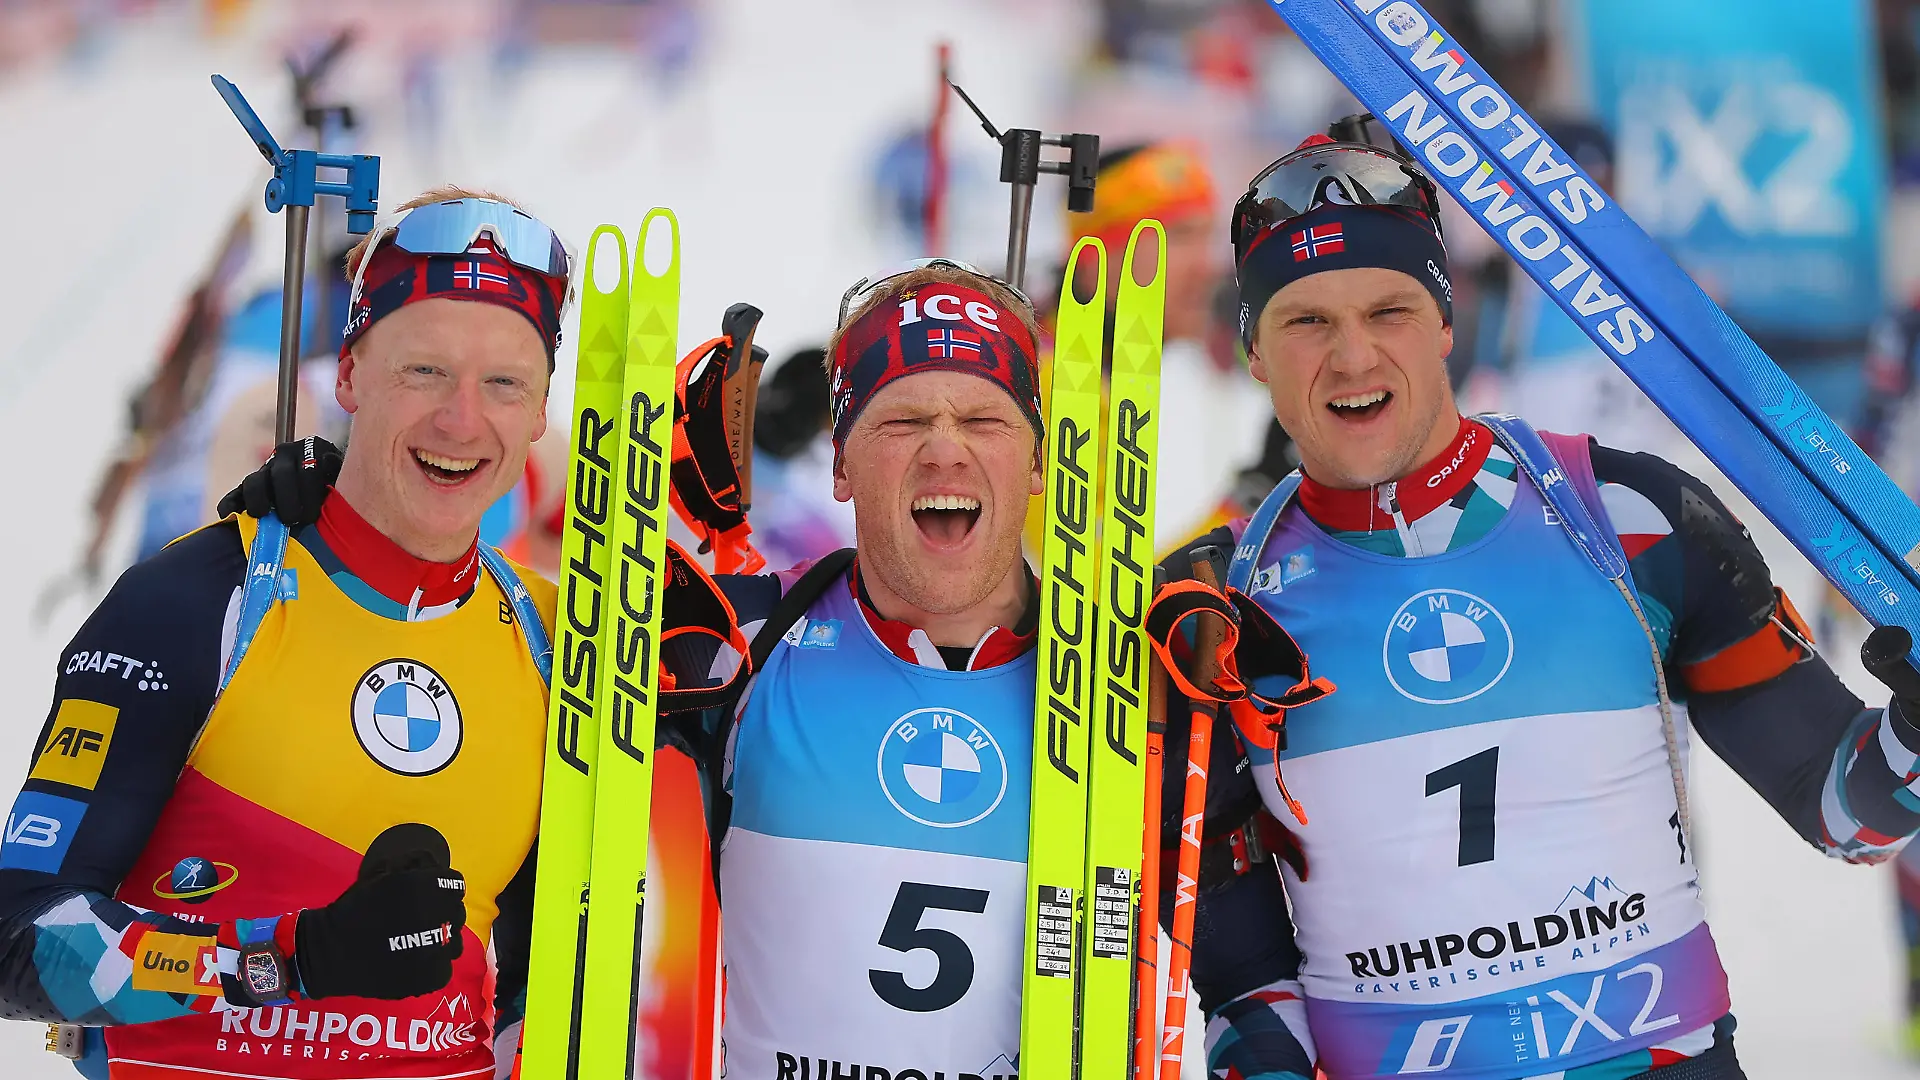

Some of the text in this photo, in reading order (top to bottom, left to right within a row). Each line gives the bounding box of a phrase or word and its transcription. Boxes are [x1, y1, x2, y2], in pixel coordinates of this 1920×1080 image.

[1354, 0, 1605, 224] SALOMO
[1385, 90, 1655, 355] SALOMON
[898, 291, 1001, 332] ice
[557, 407, 615, 777] FISCHER
[612, 391, 665, 765] FISCHER
[1048, 417, 1090, 784] FISCHER
[1106, 398, 1151, 767] FISCHER
[1396, 595, 1489, 633] BMW
[65, 650, 144, 680] CRAFT
[366, 664, 446, 700] BMW
[897, 714, 990, 751] BMW
[1425, 745, 1499, 867] 1
[143, 950, 190, 974] Uno
[868, 881, 990, 1013] 5
[1345, 892, 1646, 979] RUHPOLDING
[1355, 921, 1651, 994] BAYERISCHE ALPEN
[1526, 962, 1681, 1060] iX2
